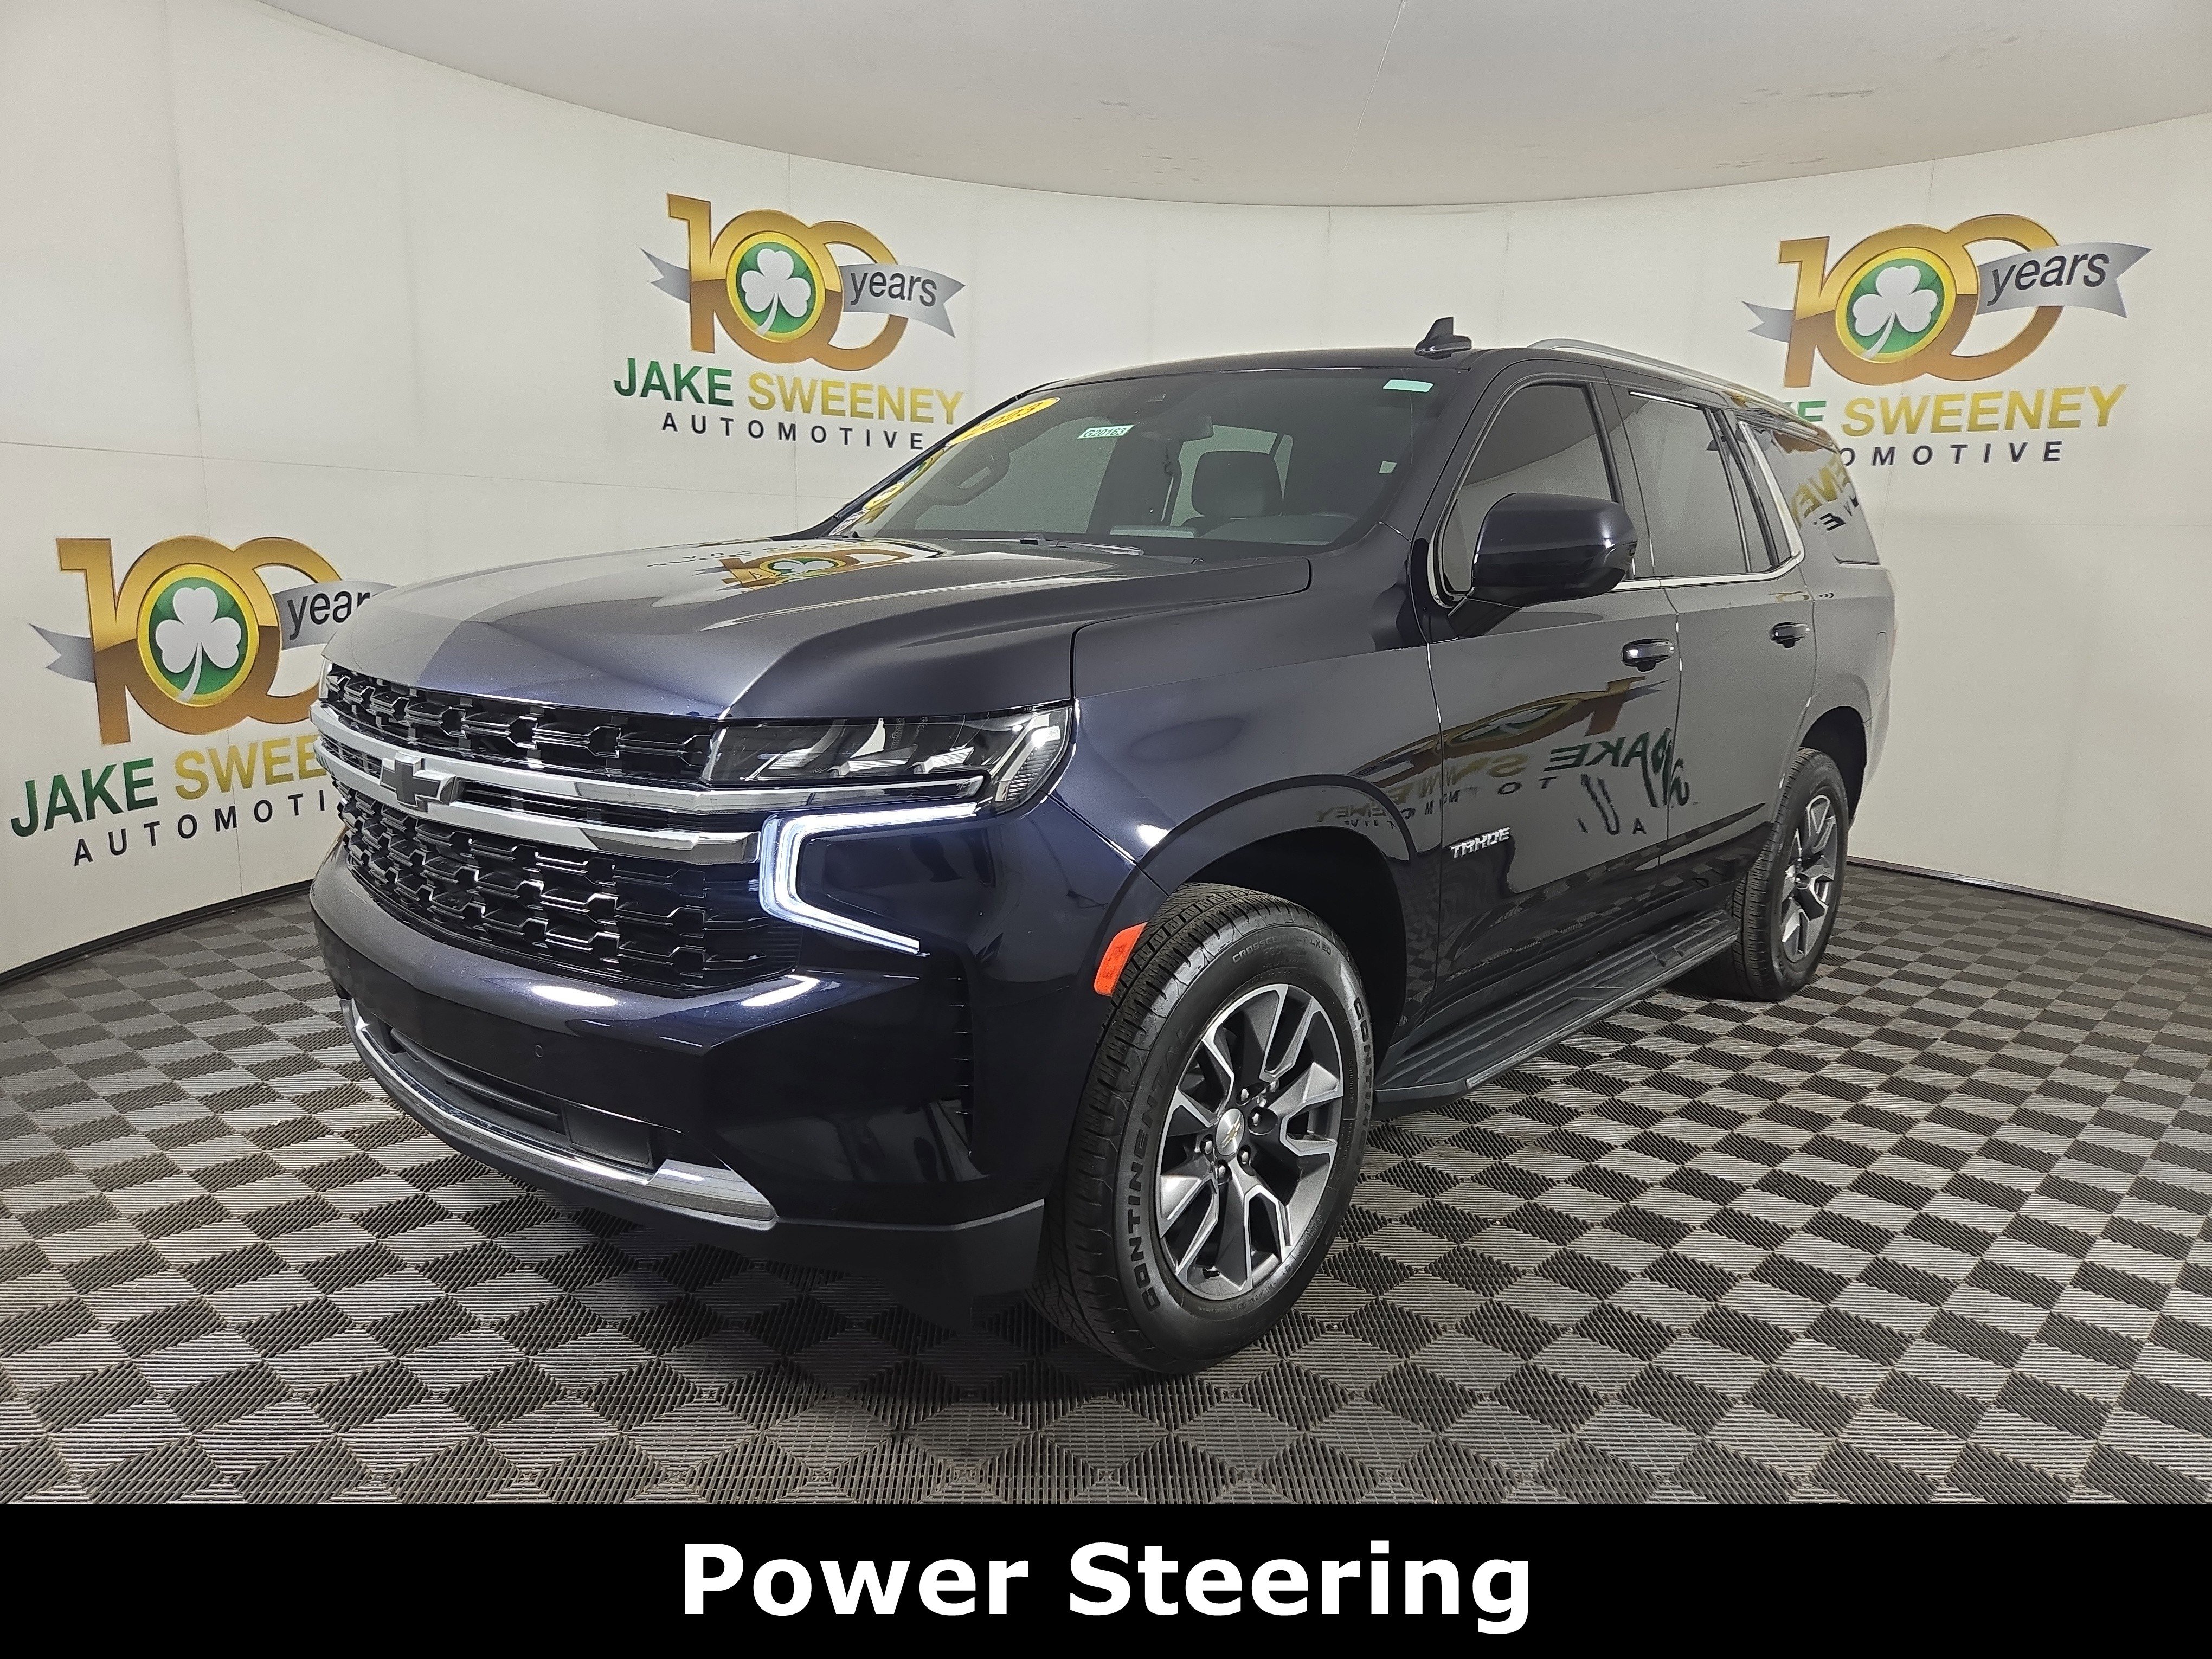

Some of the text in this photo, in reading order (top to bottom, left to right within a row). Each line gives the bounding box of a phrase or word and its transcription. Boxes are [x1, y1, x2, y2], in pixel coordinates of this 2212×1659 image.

[850, 270, 937, 306] years
[1986, 251, 2110, 306] years
[614, 358, 967, 425] JAKE SWEENEY
[1841, 384, 2129, 437] SWEENEY
[661, 412, 923, 451] AUTOMOTIVE
[1083, 428, 1127, 437] G20163
[1840, 440, 2063, 467] OMOTIVE
[287, 591, 378, 641] year
[10, 734, 327, 838] JAKE SWEE
[74, 789, 325, 867] AUTOMOTI
[1450, 827, 1511, 859] TAHOE
[1128, 1024, 1194, 1312] CONTINENTAL
